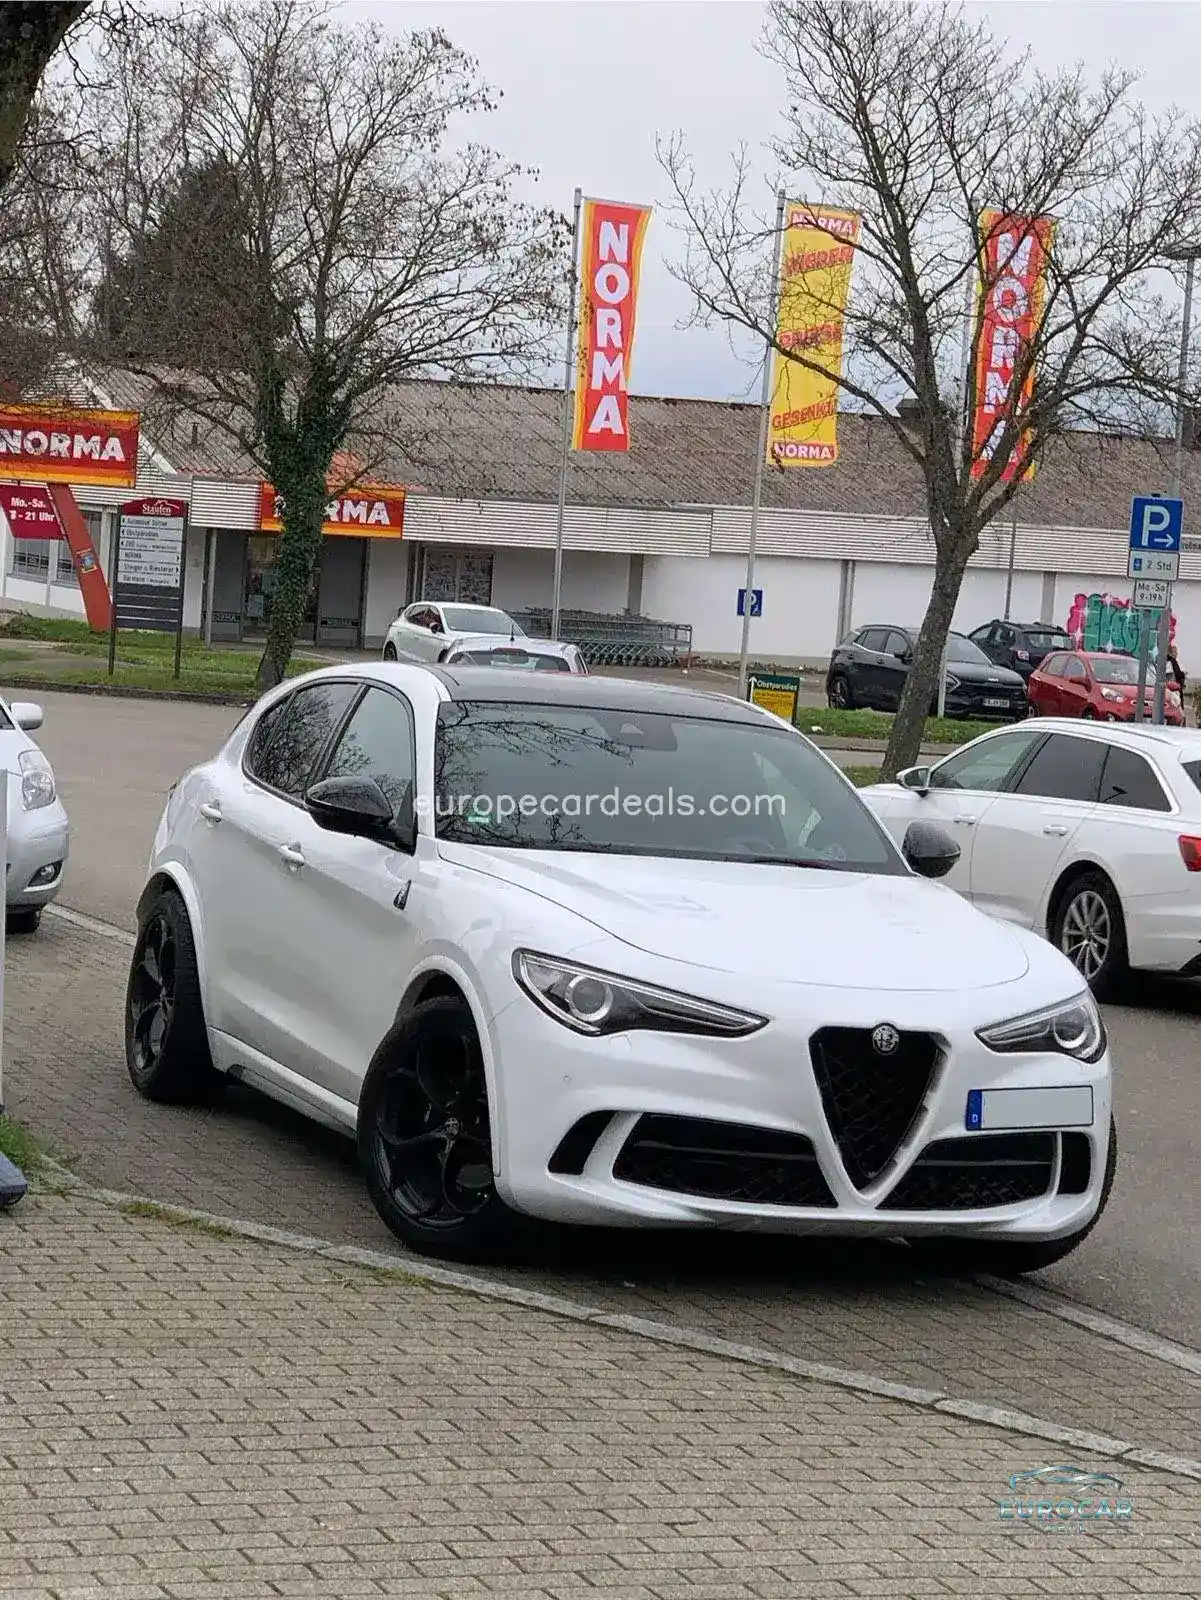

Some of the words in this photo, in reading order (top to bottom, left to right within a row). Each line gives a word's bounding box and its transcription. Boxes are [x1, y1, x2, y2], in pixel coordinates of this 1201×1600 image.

[588, 221, 630, 434] NORMA
[0, 428, 125, 461] NORMA
[774, 443, 832, 459] NORMA
[25, 511, 36, 521] 21
[39, 511, 55, 522] Uhr
[142, 503, 172, 514] Staufen
[1141, 505, 1171, 546] P
[1147, 560, 1153, 569] 2
